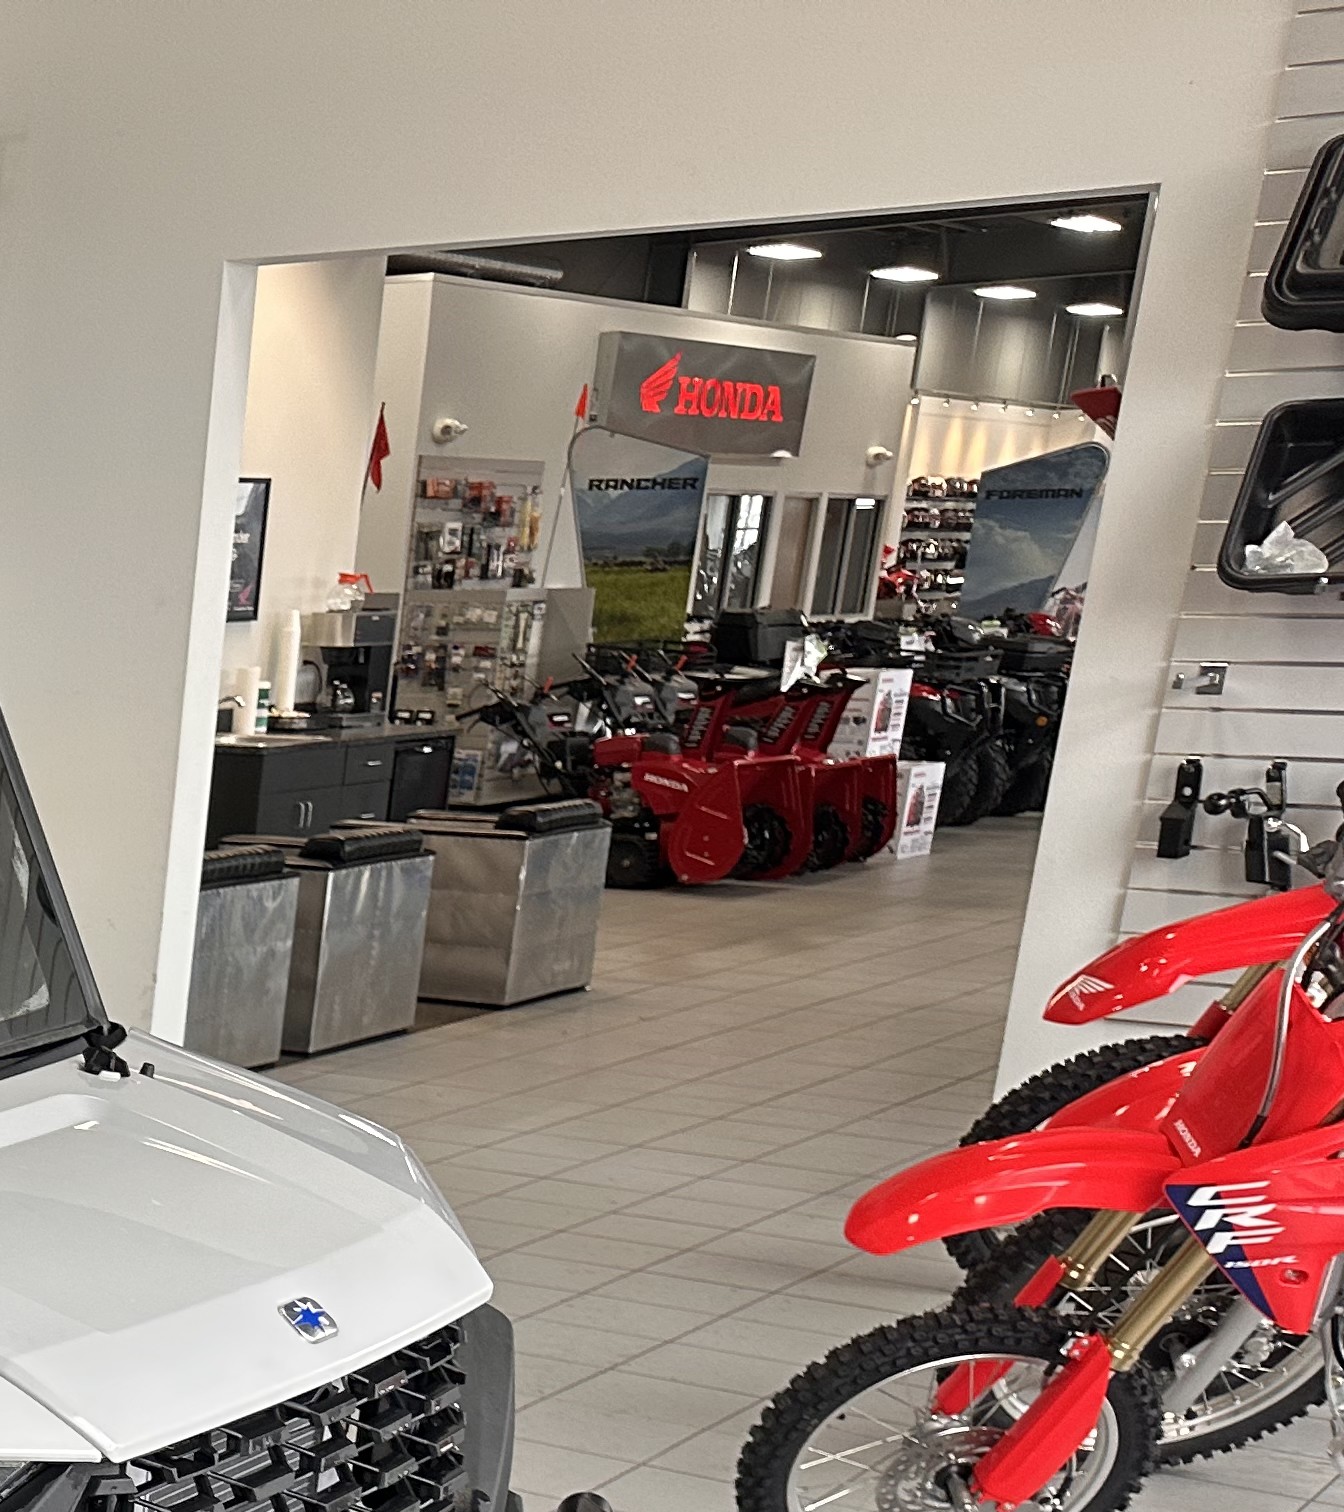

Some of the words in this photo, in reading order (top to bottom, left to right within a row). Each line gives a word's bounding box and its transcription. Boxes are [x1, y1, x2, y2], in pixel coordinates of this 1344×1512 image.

[673, 375, 784, 423] HONDA
[588, 475, 699, 492] RANCHER
[984, 486, 1084, 500] FOREMAN
[643, 772, 689, 793] HONDA
[1173, 1118, 1202, 1159] HONDA
